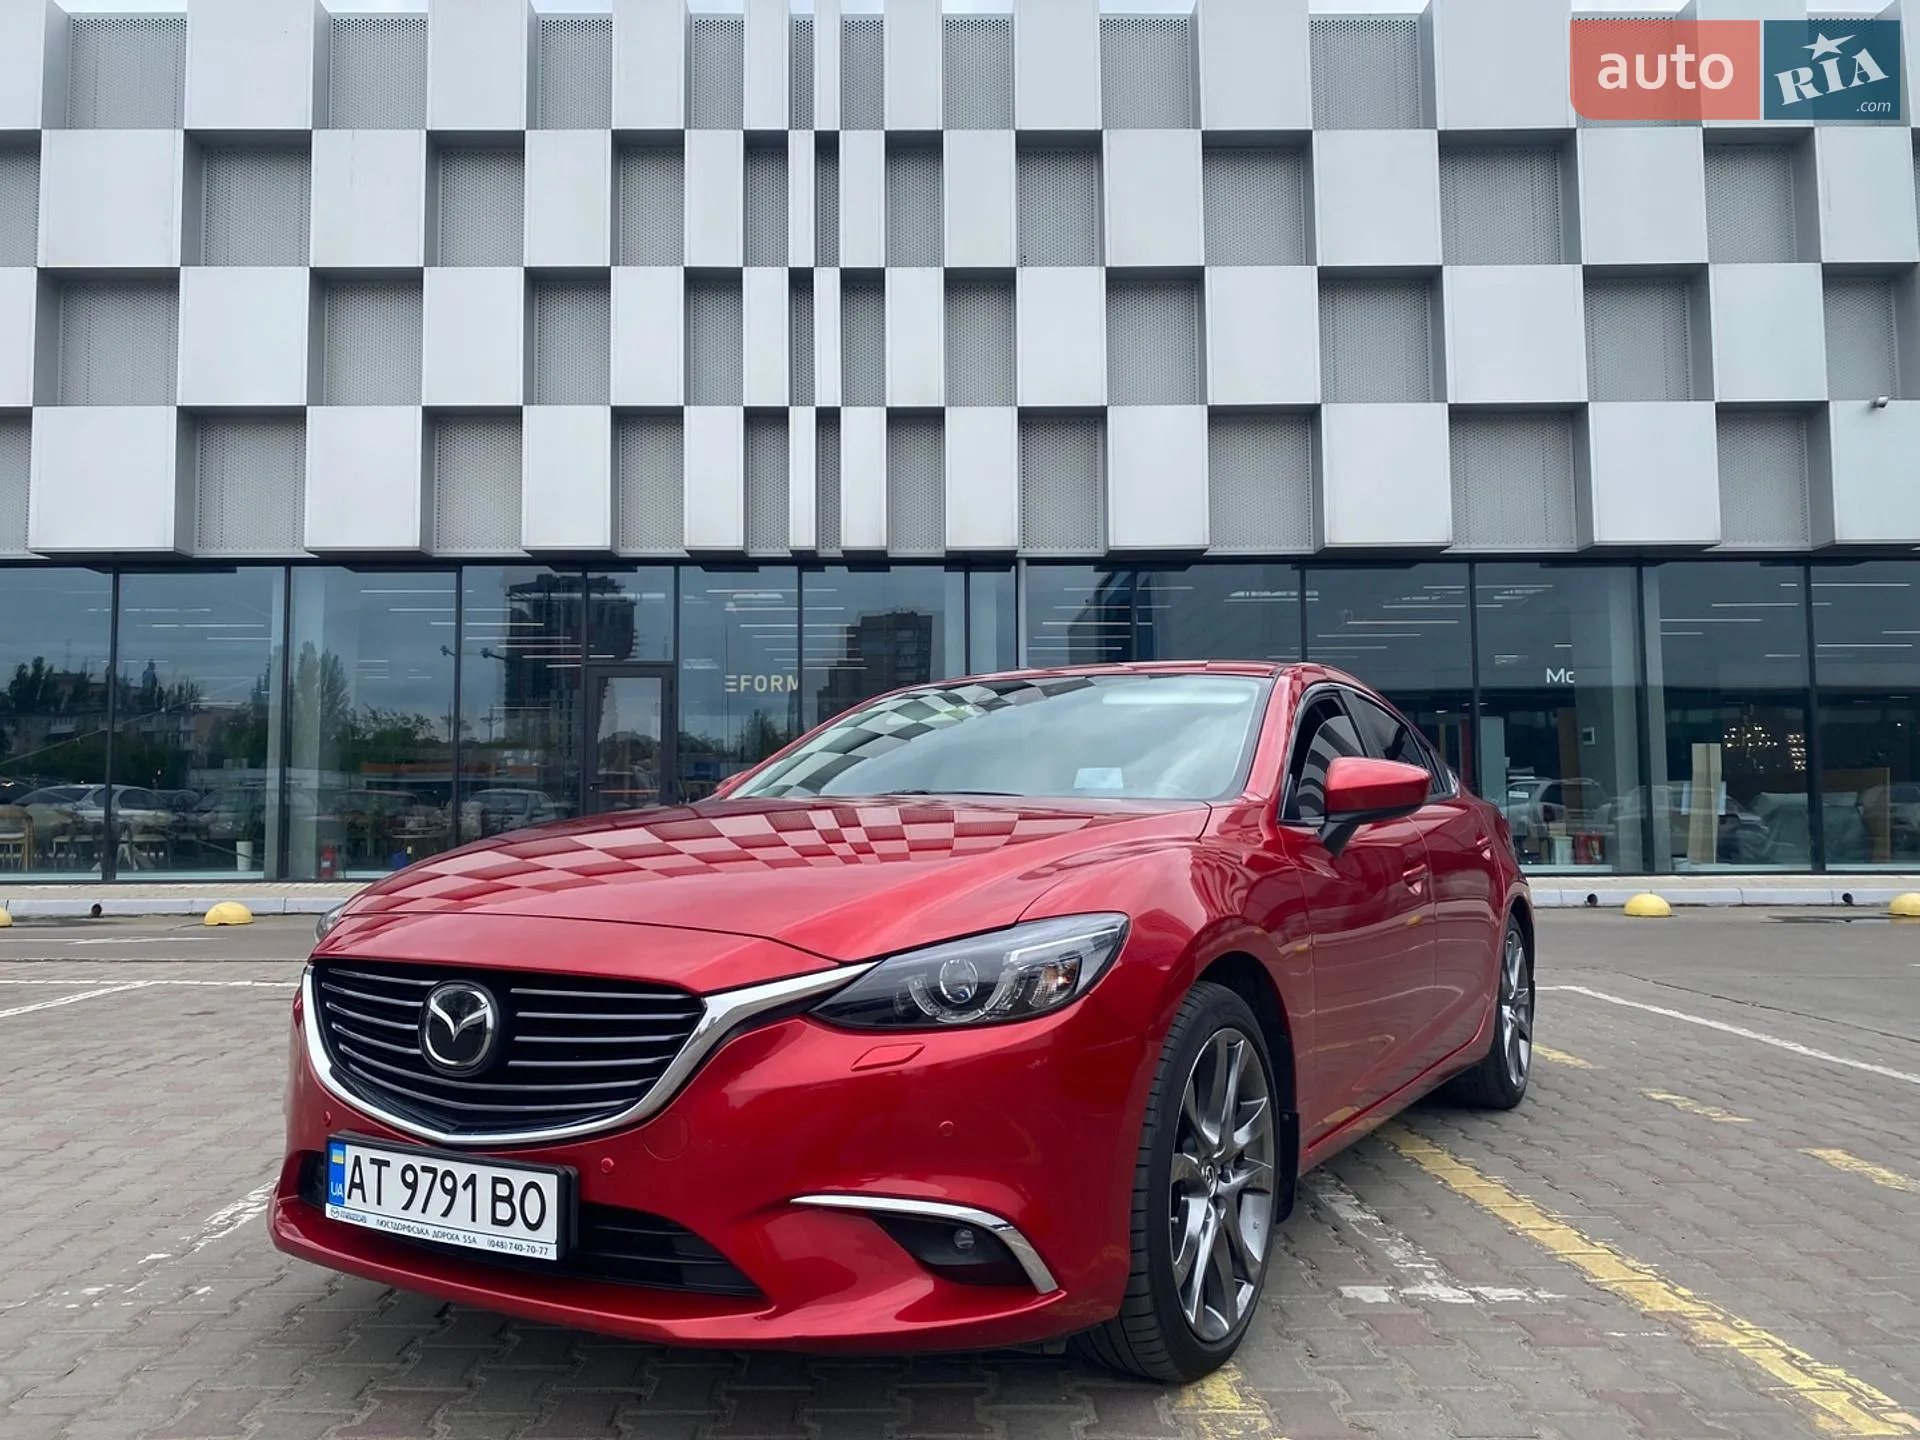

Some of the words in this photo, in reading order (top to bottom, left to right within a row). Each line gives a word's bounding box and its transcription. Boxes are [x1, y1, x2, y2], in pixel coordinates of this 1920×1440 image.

[330, 1181, 344, 1198] UA
[347, 1154, 391, 1206] AT
[400, 1163, 477, 1223] 9791
[490, 1175, 547, 1232] BO
